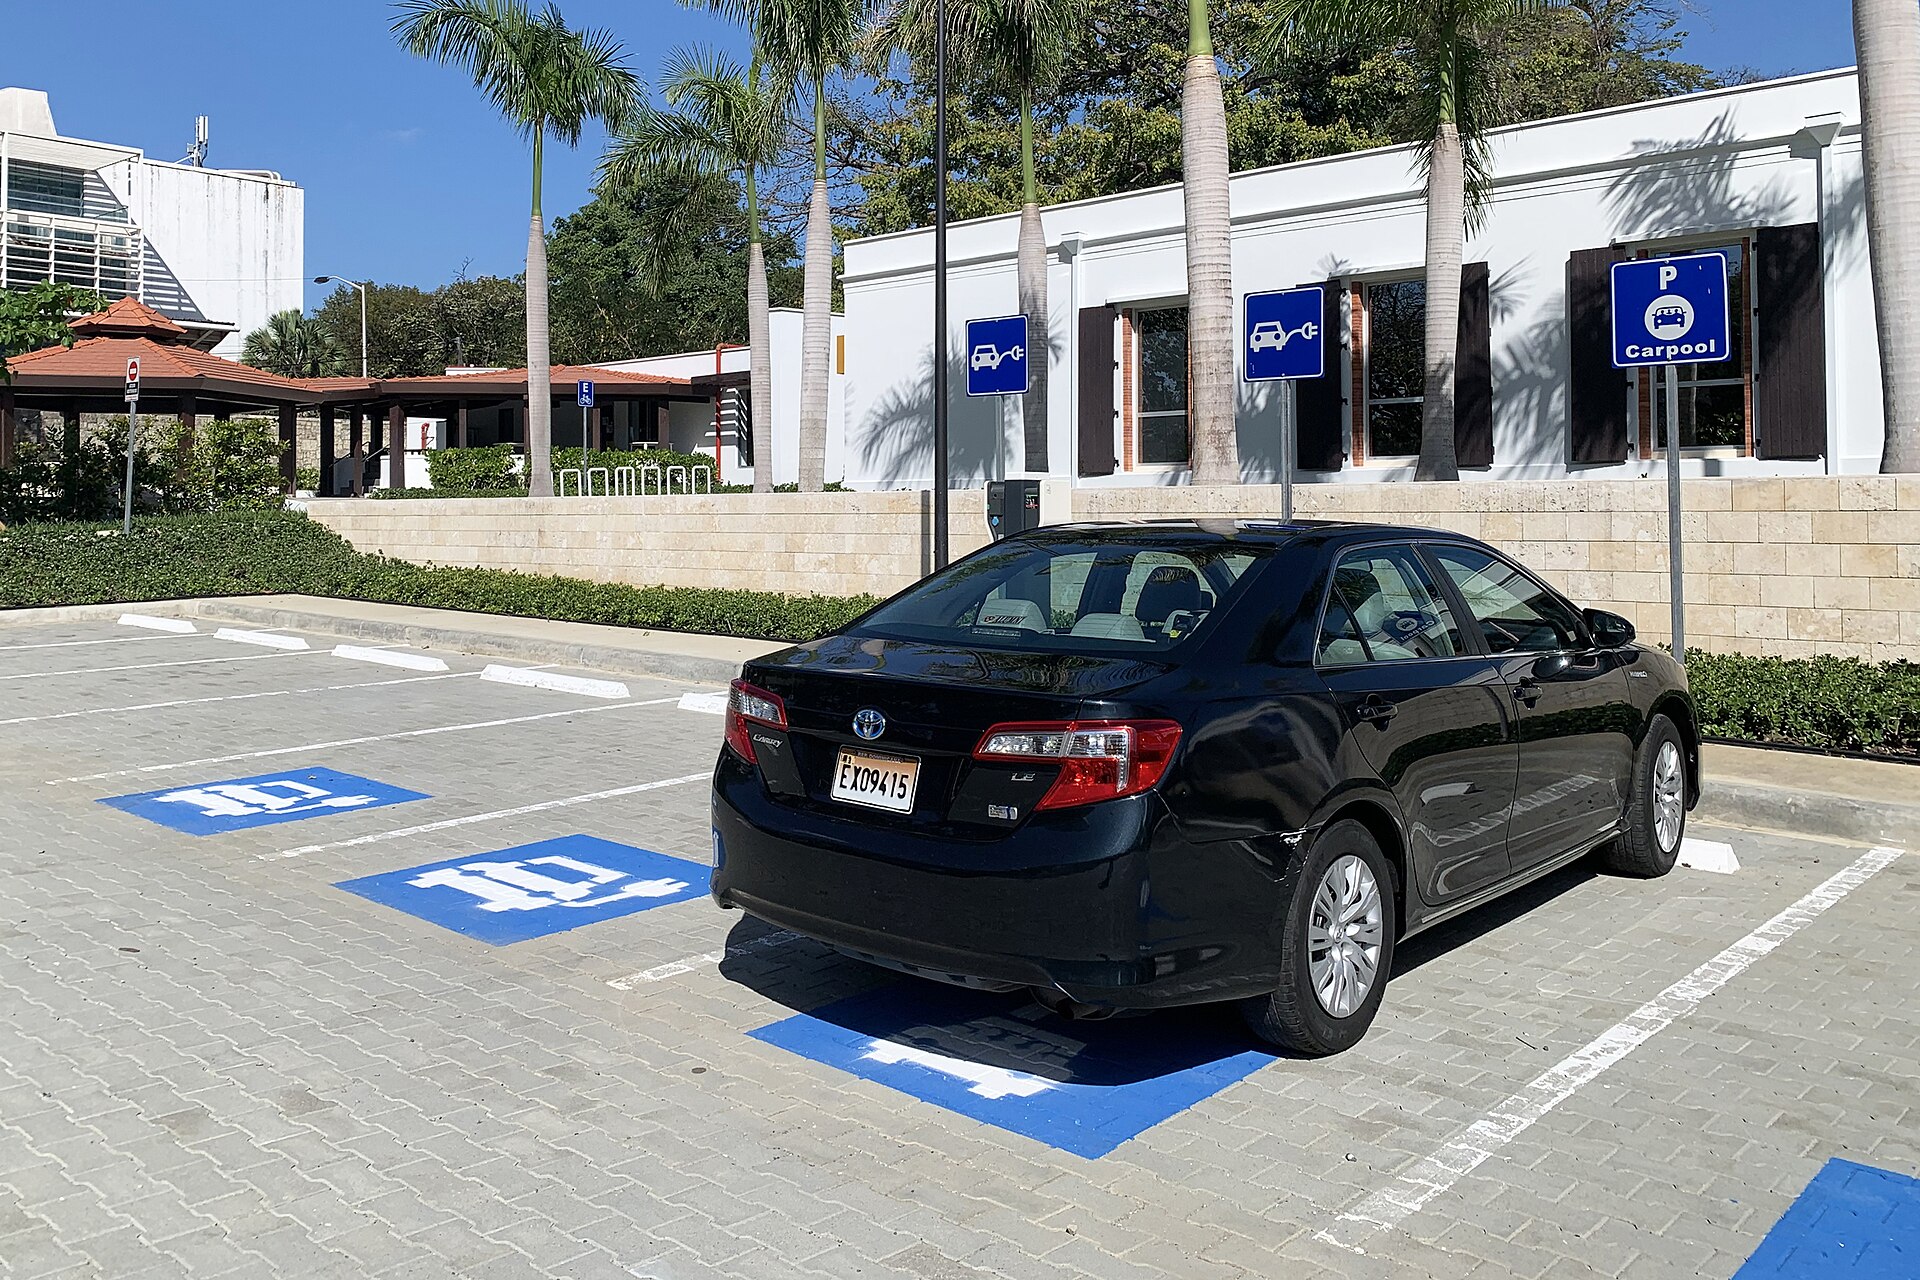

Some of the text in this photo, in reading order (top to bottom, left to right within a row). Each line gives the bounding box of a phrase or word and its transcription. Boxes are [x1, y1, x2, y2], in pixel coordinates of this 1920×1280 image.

[1659, 265, 1678, 290] P
[1625, 339, 1716, 360] Carpool
[582, 382, 589, 393] E
[839, 763, 910, 799] EX09415
